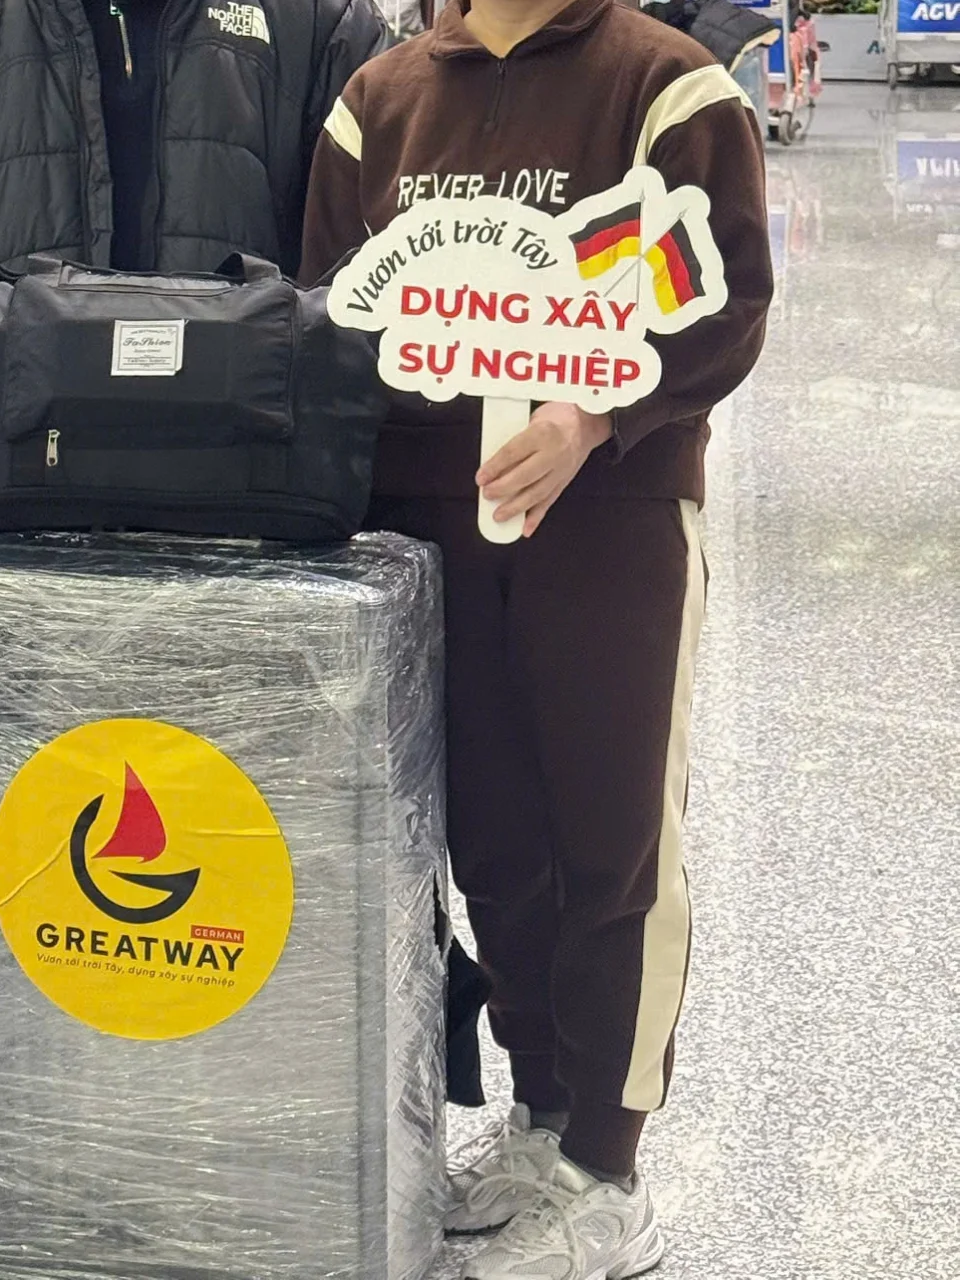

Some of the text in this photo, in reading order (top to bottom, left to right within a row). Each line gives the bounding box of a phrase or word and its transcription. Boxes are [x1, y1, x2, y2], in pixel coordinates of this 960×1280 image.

[207, 7, 252, 27] NORTH
[227, 1, 252, 15] THE
[911, 2, 960, 21] ACV
[220, 20, 252, 36] FACE
[397, 168, 570, 209] REVER LOVE
[347, 217, 558, 314] Vươn tới trời Tây
[400, 284, 637, 331] DỰNG XÂY
[398, 340, 641, 396] SỰ NGHIỆP
[36, 923, 244, 972] GREATWAY
[193, 926, 242, 942] GERMAN
